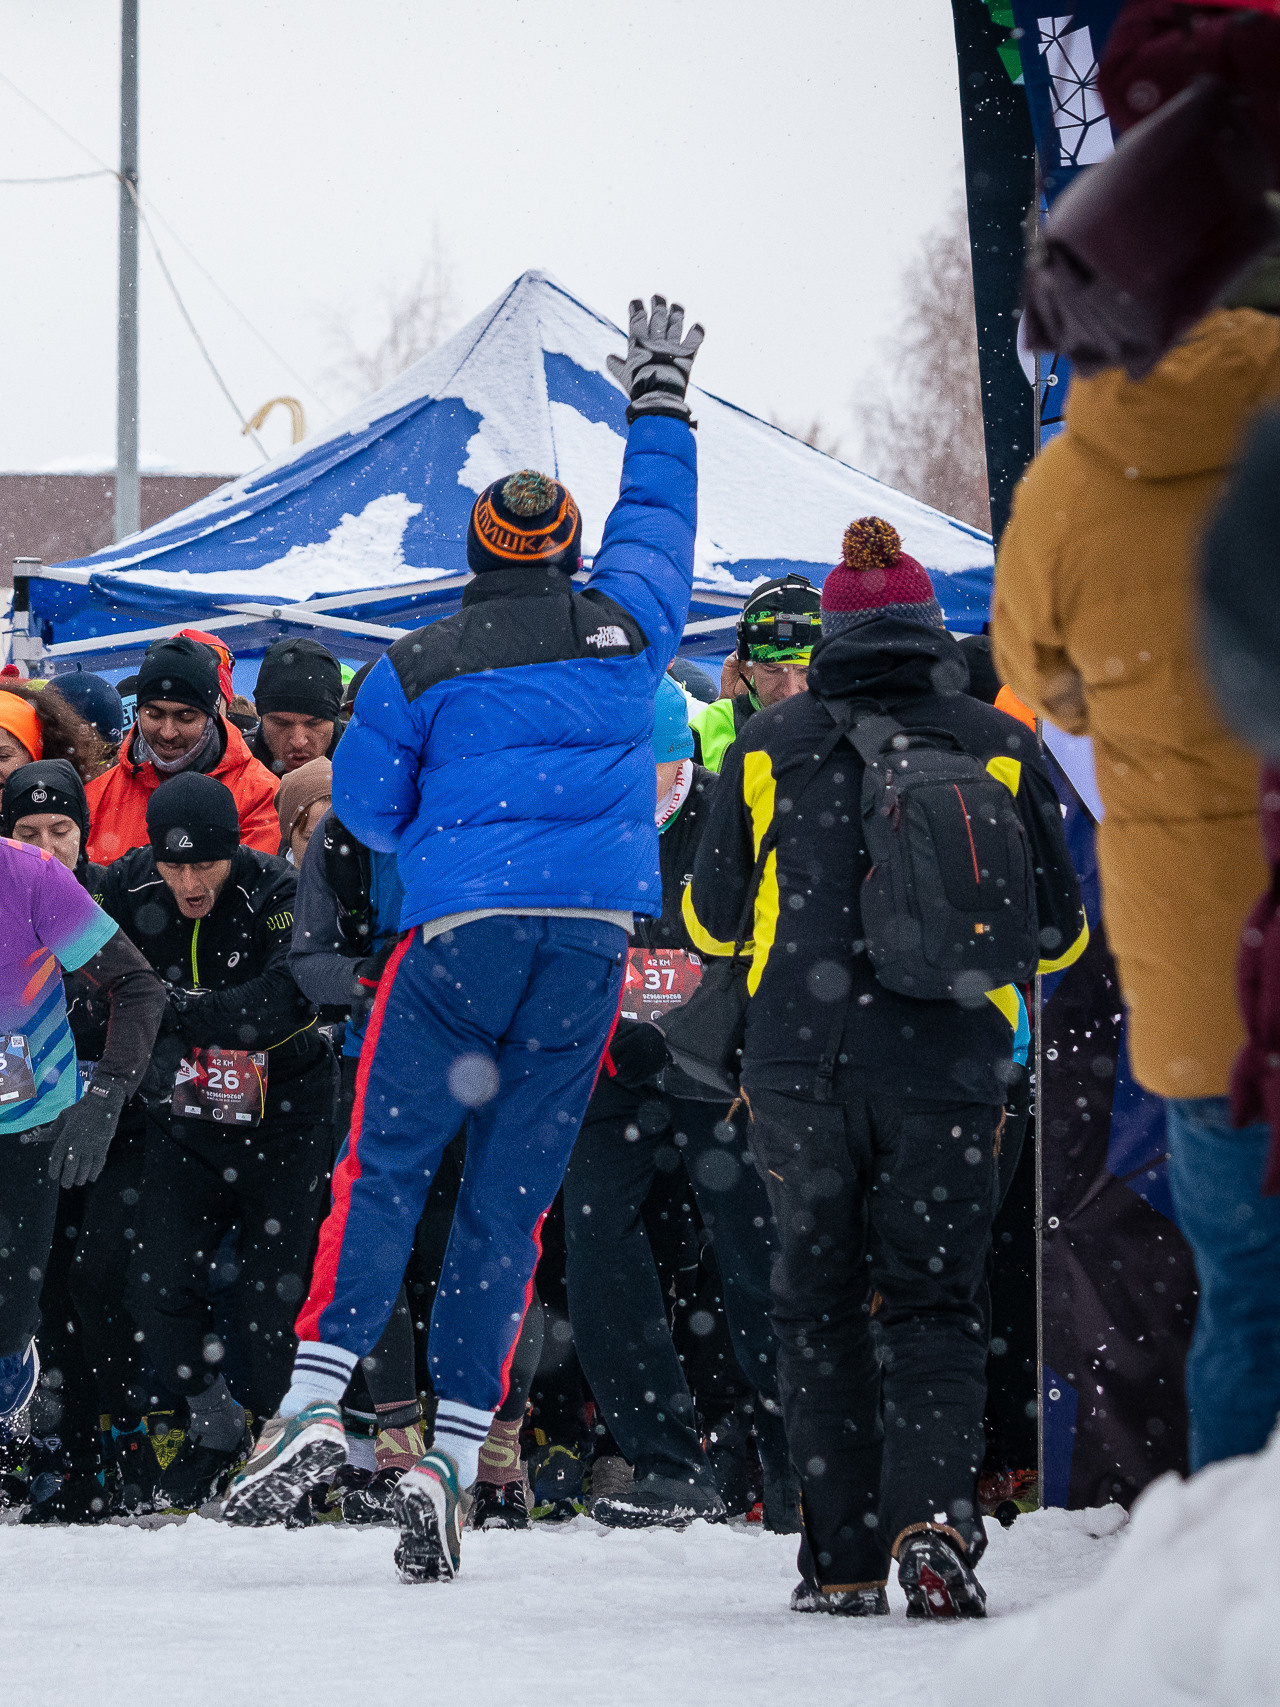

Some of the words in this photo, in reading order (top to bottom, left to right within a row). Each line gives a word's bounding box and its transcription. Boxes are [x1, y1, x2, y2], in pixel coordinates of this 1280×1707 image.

[647, 959, 658, 967] 42
[659, 959, 671, 967] KM
[644, 968, 676, 990] 37
[223, 1059, 234, 1067] KM
[207, 1068, 240, 1090] 26
